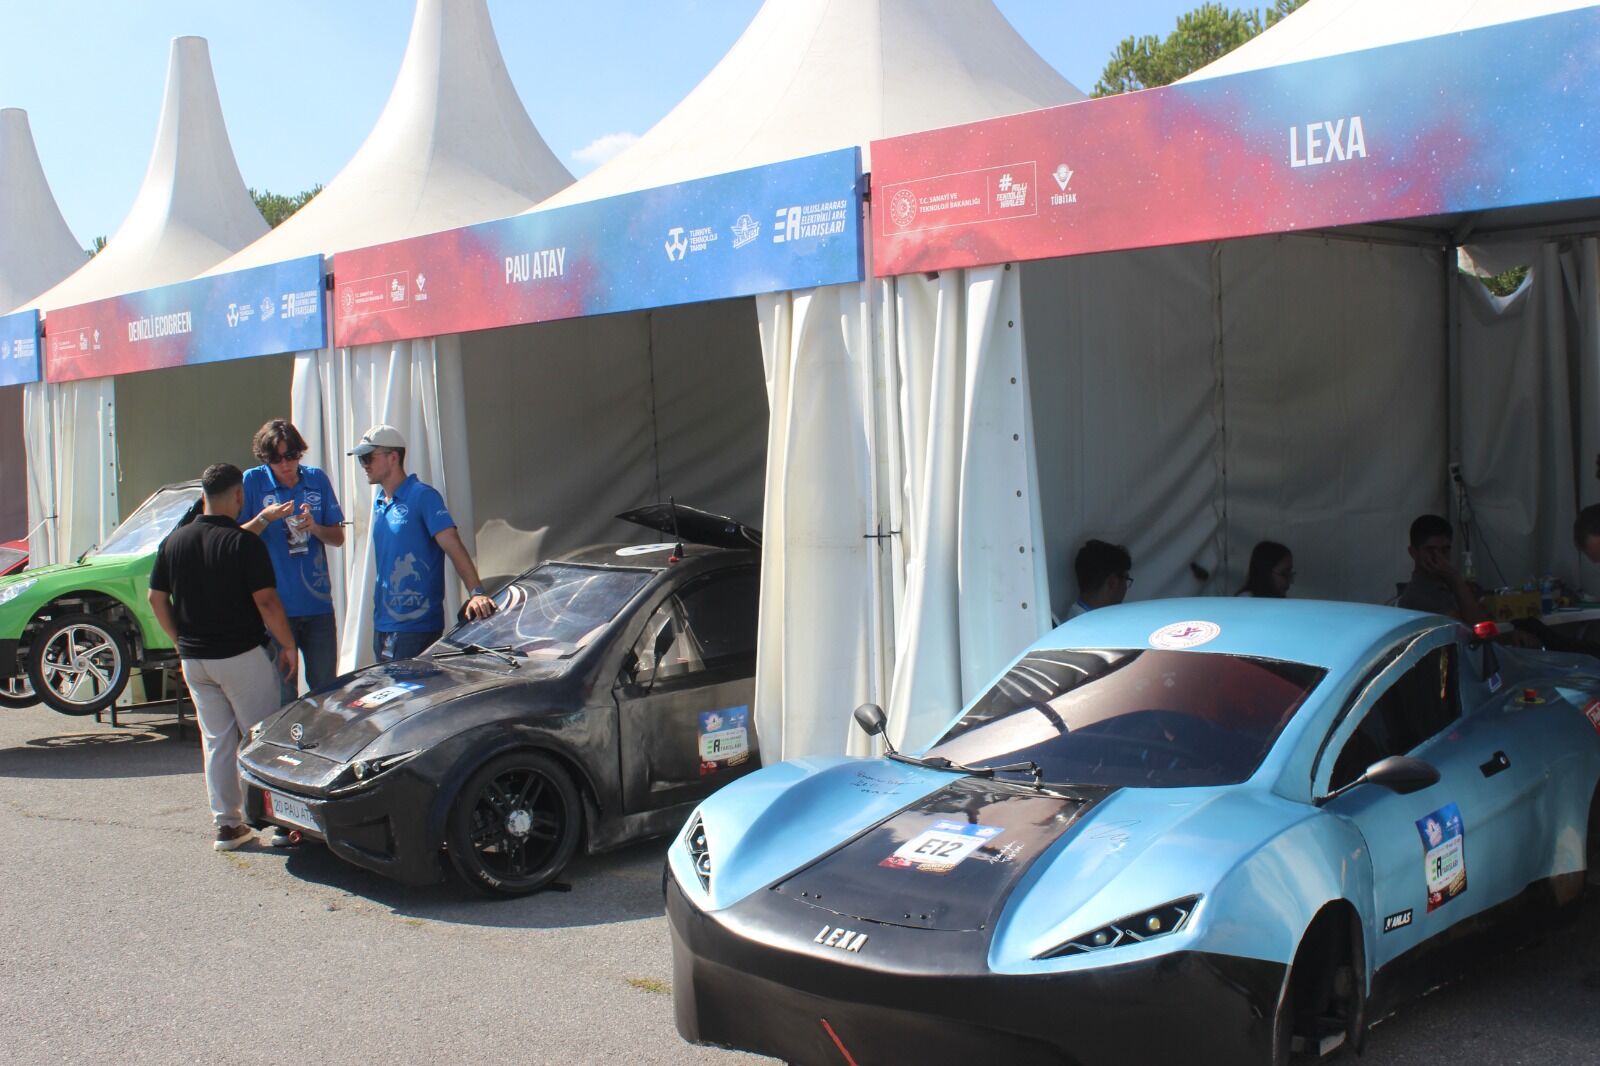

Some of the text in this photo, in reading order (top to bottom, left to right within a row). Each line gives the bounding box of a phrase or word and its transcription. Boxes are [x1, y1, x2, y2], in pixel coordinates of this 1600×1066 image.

[1289, 116, 1367, 168] LEXA
[1051, 193, 1077, 206] TÜBİTAK
[801, 220, 846, 239] YARIŞLARI
[505, 247, 566, 284] PAU ATAY
[128, 311, 192, 343] DENİZLİ ECOGREEN
[284, 801, 300, 819] PAU
[914, 838, 964, 858] E12
[813, 925, 868, 953] LEXA
